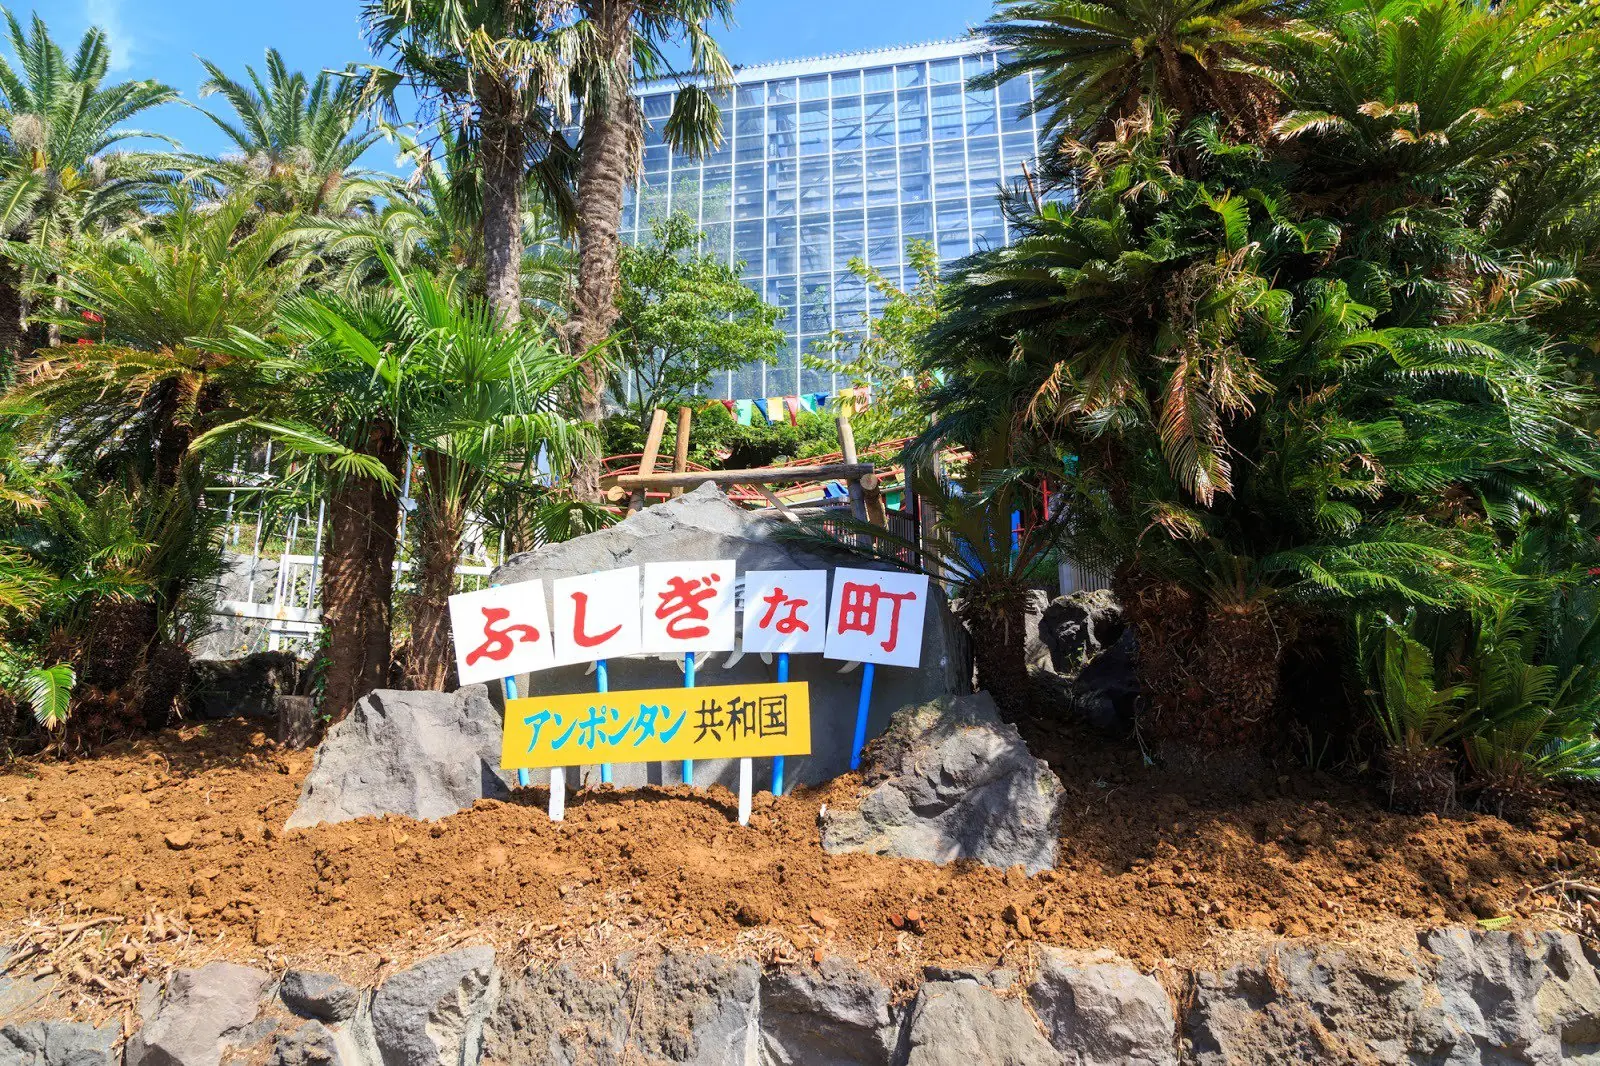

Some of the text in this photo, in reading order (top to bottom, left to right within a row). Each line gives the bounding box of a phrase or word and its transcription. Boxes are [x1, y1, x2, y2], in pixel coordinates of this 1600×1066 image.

[466, 573, 917, 666] ふしぎな町
